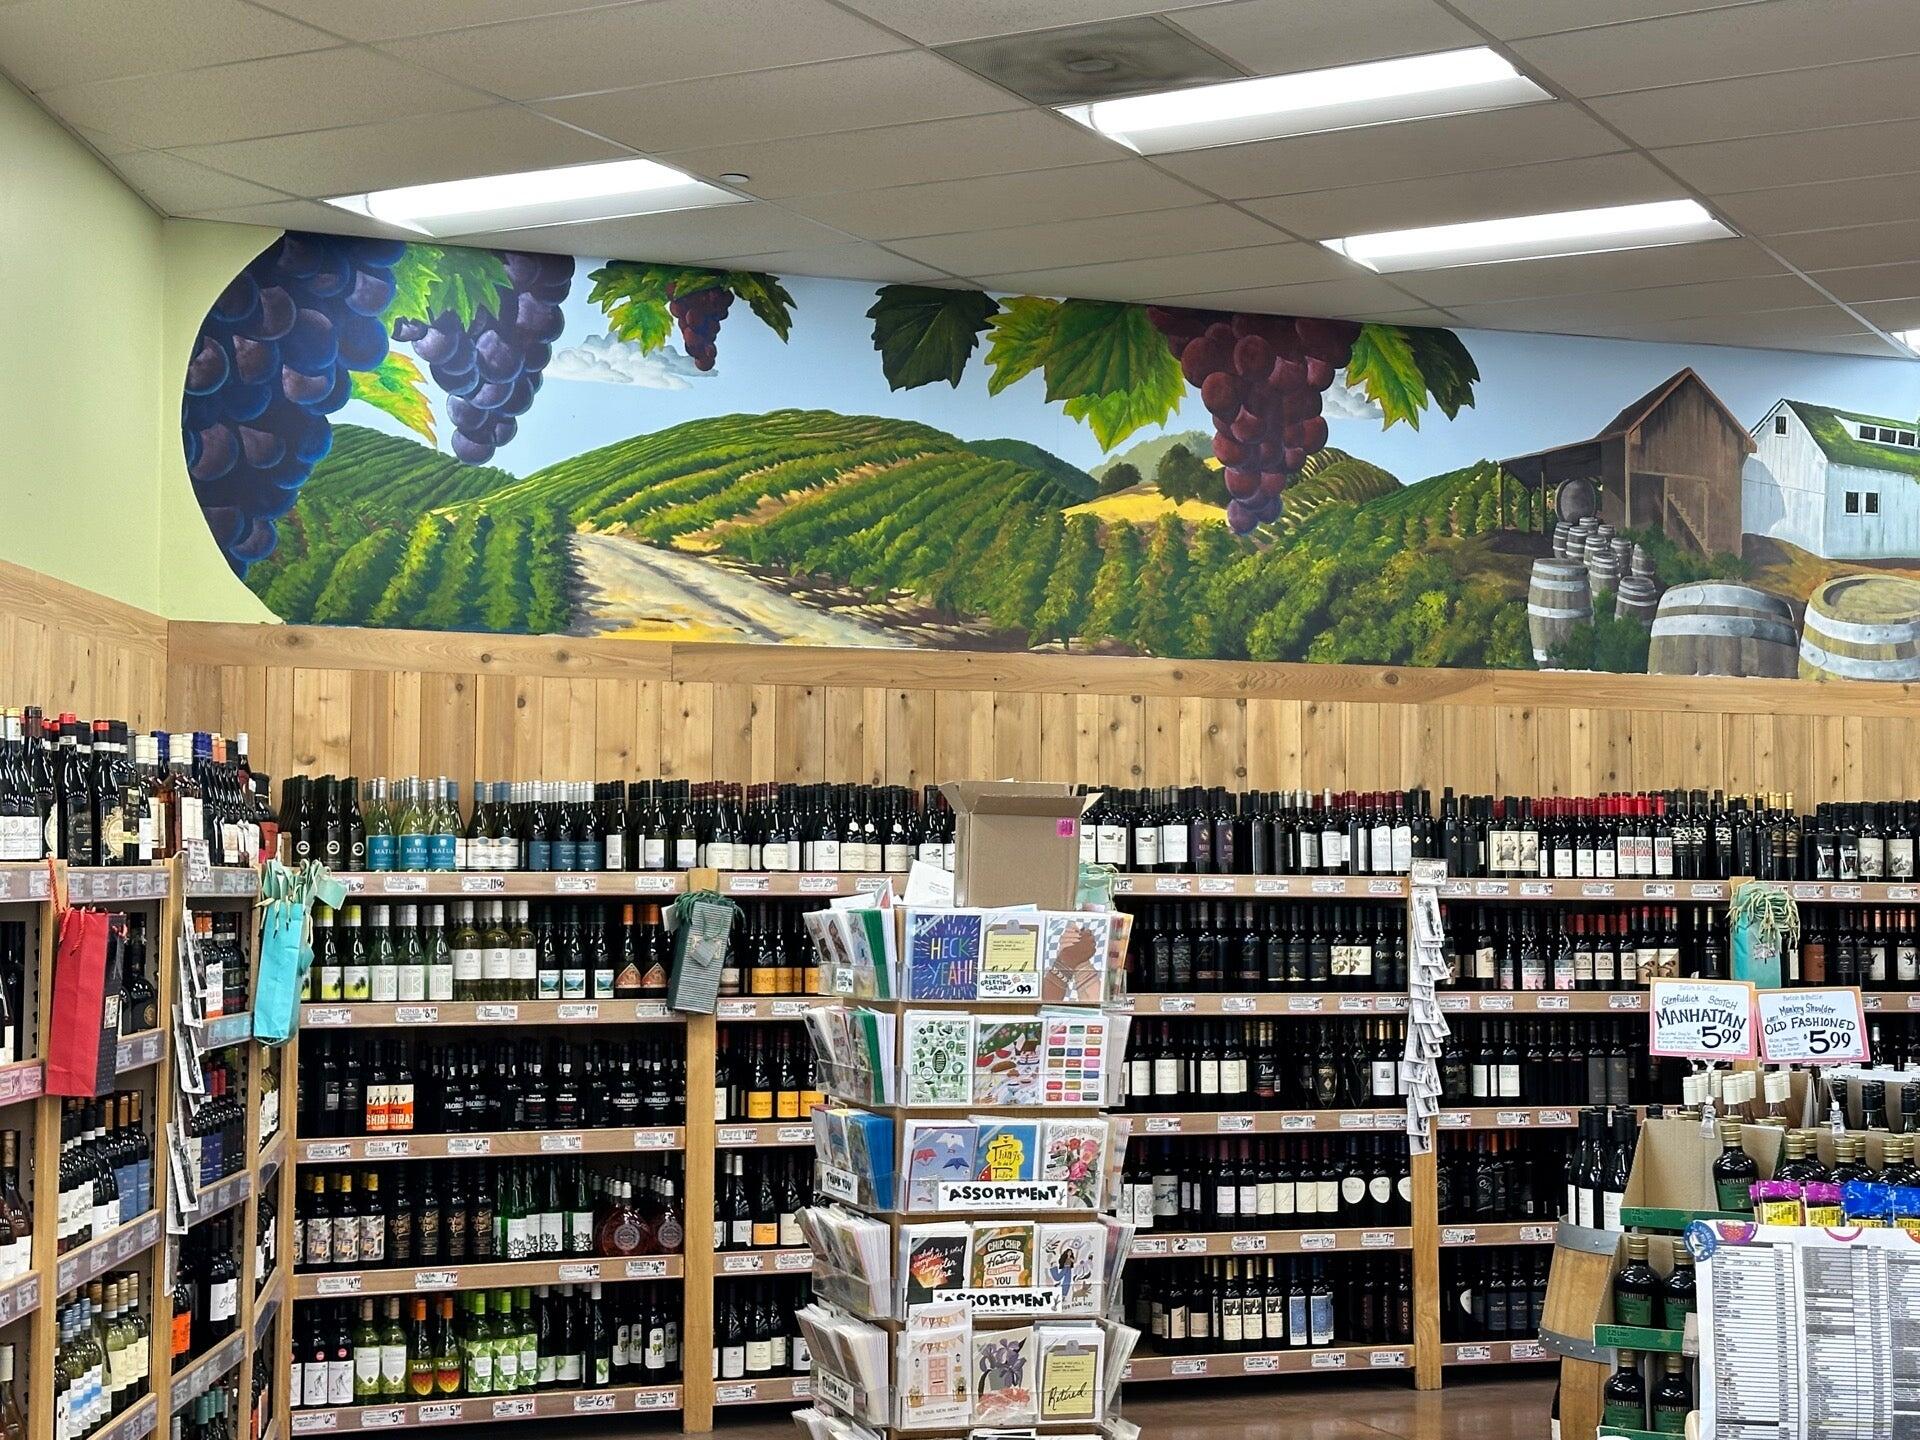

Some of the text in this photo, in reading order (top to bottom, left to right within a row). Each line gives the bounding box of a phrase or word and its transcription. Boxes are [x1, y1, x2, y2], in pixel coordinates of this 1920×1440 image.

[931, 937, 971, 960] HECK
[928, 960, 973, 986] YEAH!
[1779, 1003, 1836, 1016] Monkey Shoulder
[1655, 1007, 1747, 1030] MANHATTAN
[1765, 1016, 1856, 1035] OLD FASHIONED
[992, 1144, 1021, 1165] Things
[949, 1185, 1058, 1201] ASSORTMENT
[988, 1238, 1021, 1251] CHIP CHIP
[987, 1251, 1021, 1267] Hooray
[995, 1276, 1012, 1285] YOU
